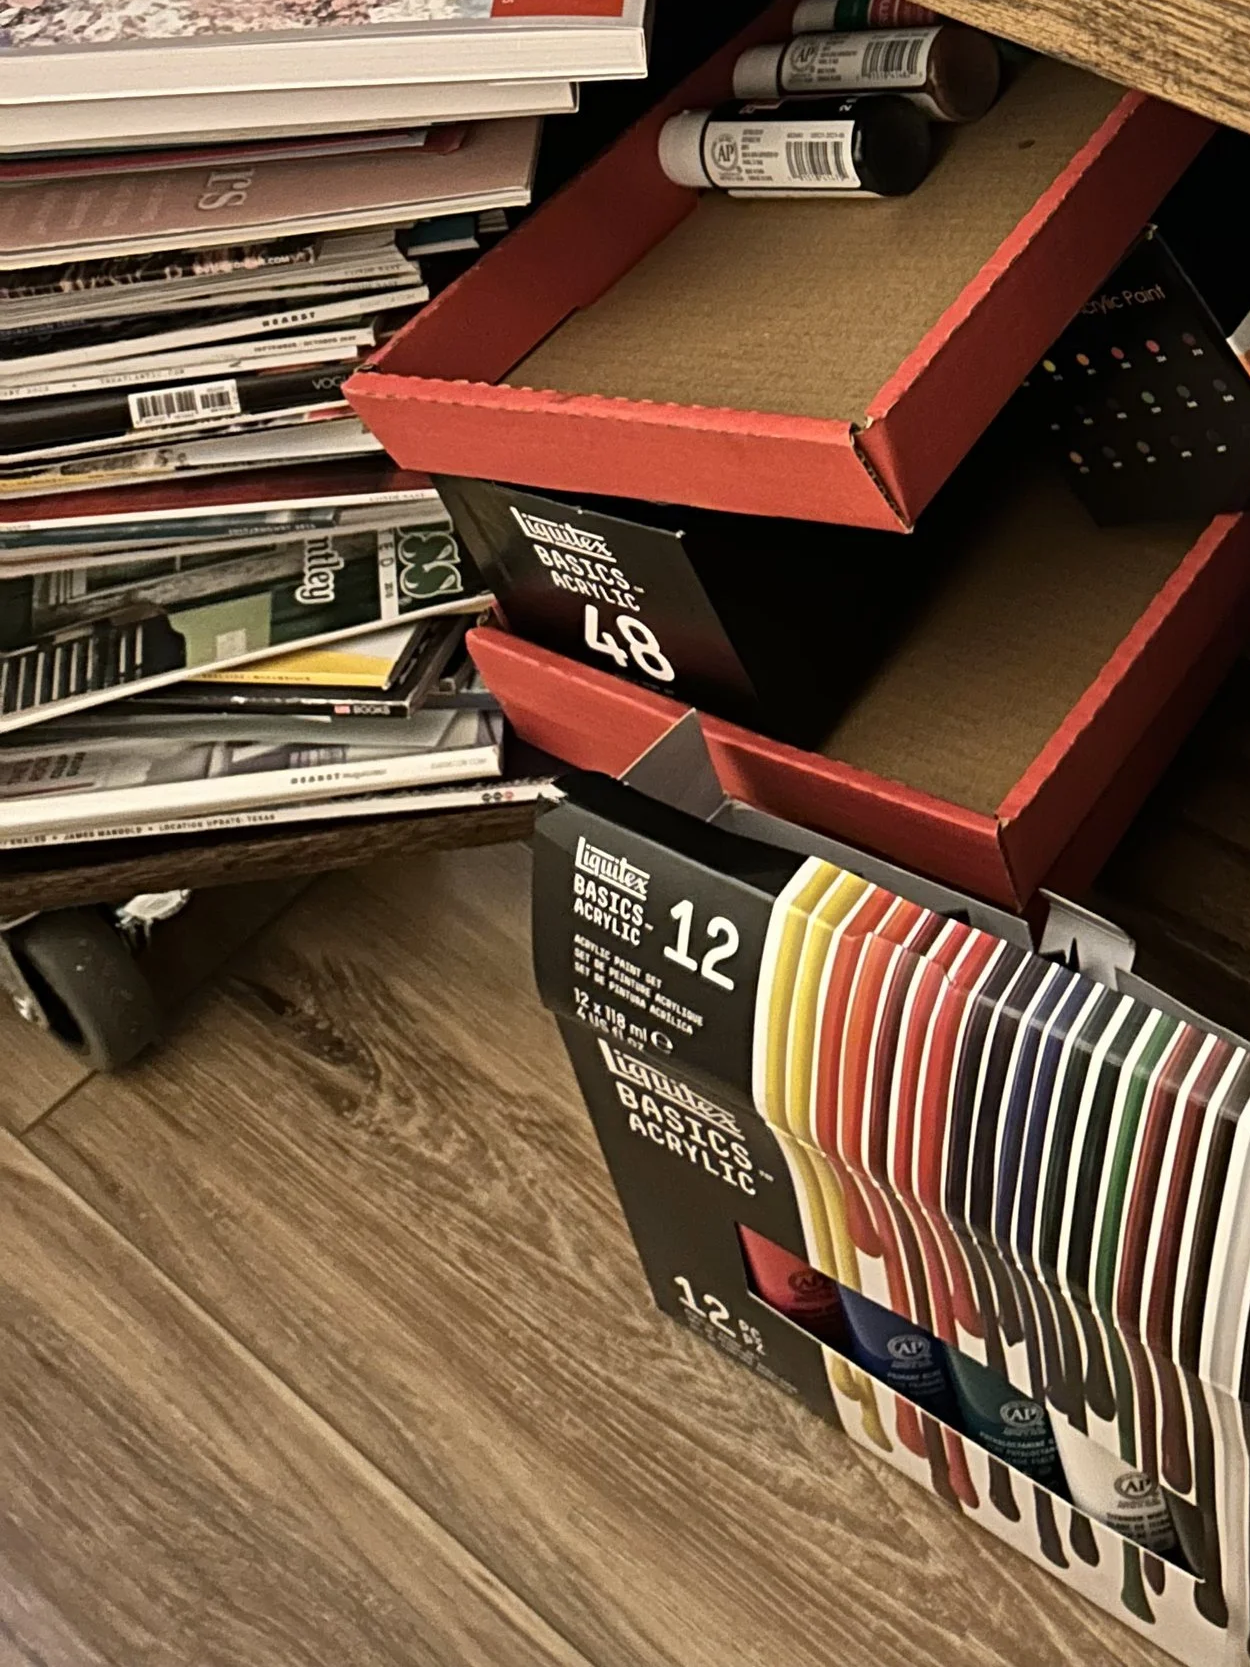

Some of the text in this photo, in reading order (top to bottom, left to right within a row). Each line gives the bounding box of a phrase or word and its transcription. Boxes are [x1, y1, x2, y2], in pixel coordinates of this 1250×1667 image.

[262, 310, 317, 328] HEARST
[1122, 283, 1167, 306] Paint
[509, 505, 617, 563] Liquitex
[533, 544, 631, 591] BASICS
[550, 570, 641, 612] ACRYLIC
[584, 603, 675, 682] 48
[353, 704, 391, 715] BOOKS
[574, 835, 651, 902] Liquitex
[573, 872, 644, 927] BASICS
[573, 897, 740, 992] ACRYLIC 12
[574, 933, 663, 990] ACRYLIC PAINT SET
[574, 961, 591, 978] SET
[593, 972, 606, 987] DE
[608, 980, 647, 1010] PINTURA
[574, 946, 704, 1027] SET DE PEINTURE ACRYLIQUE
[573, 986, 648, 1043] 12 x 118 ml
[588, 1012, 610, 1035] US
[597, 1037, 746, 1141] Liquitex
[615, 1080, 753, 1171] BASICS
[628, 1112, 757, 1196] ACRYLIC
[673, 1275, 737, 1339] 12
